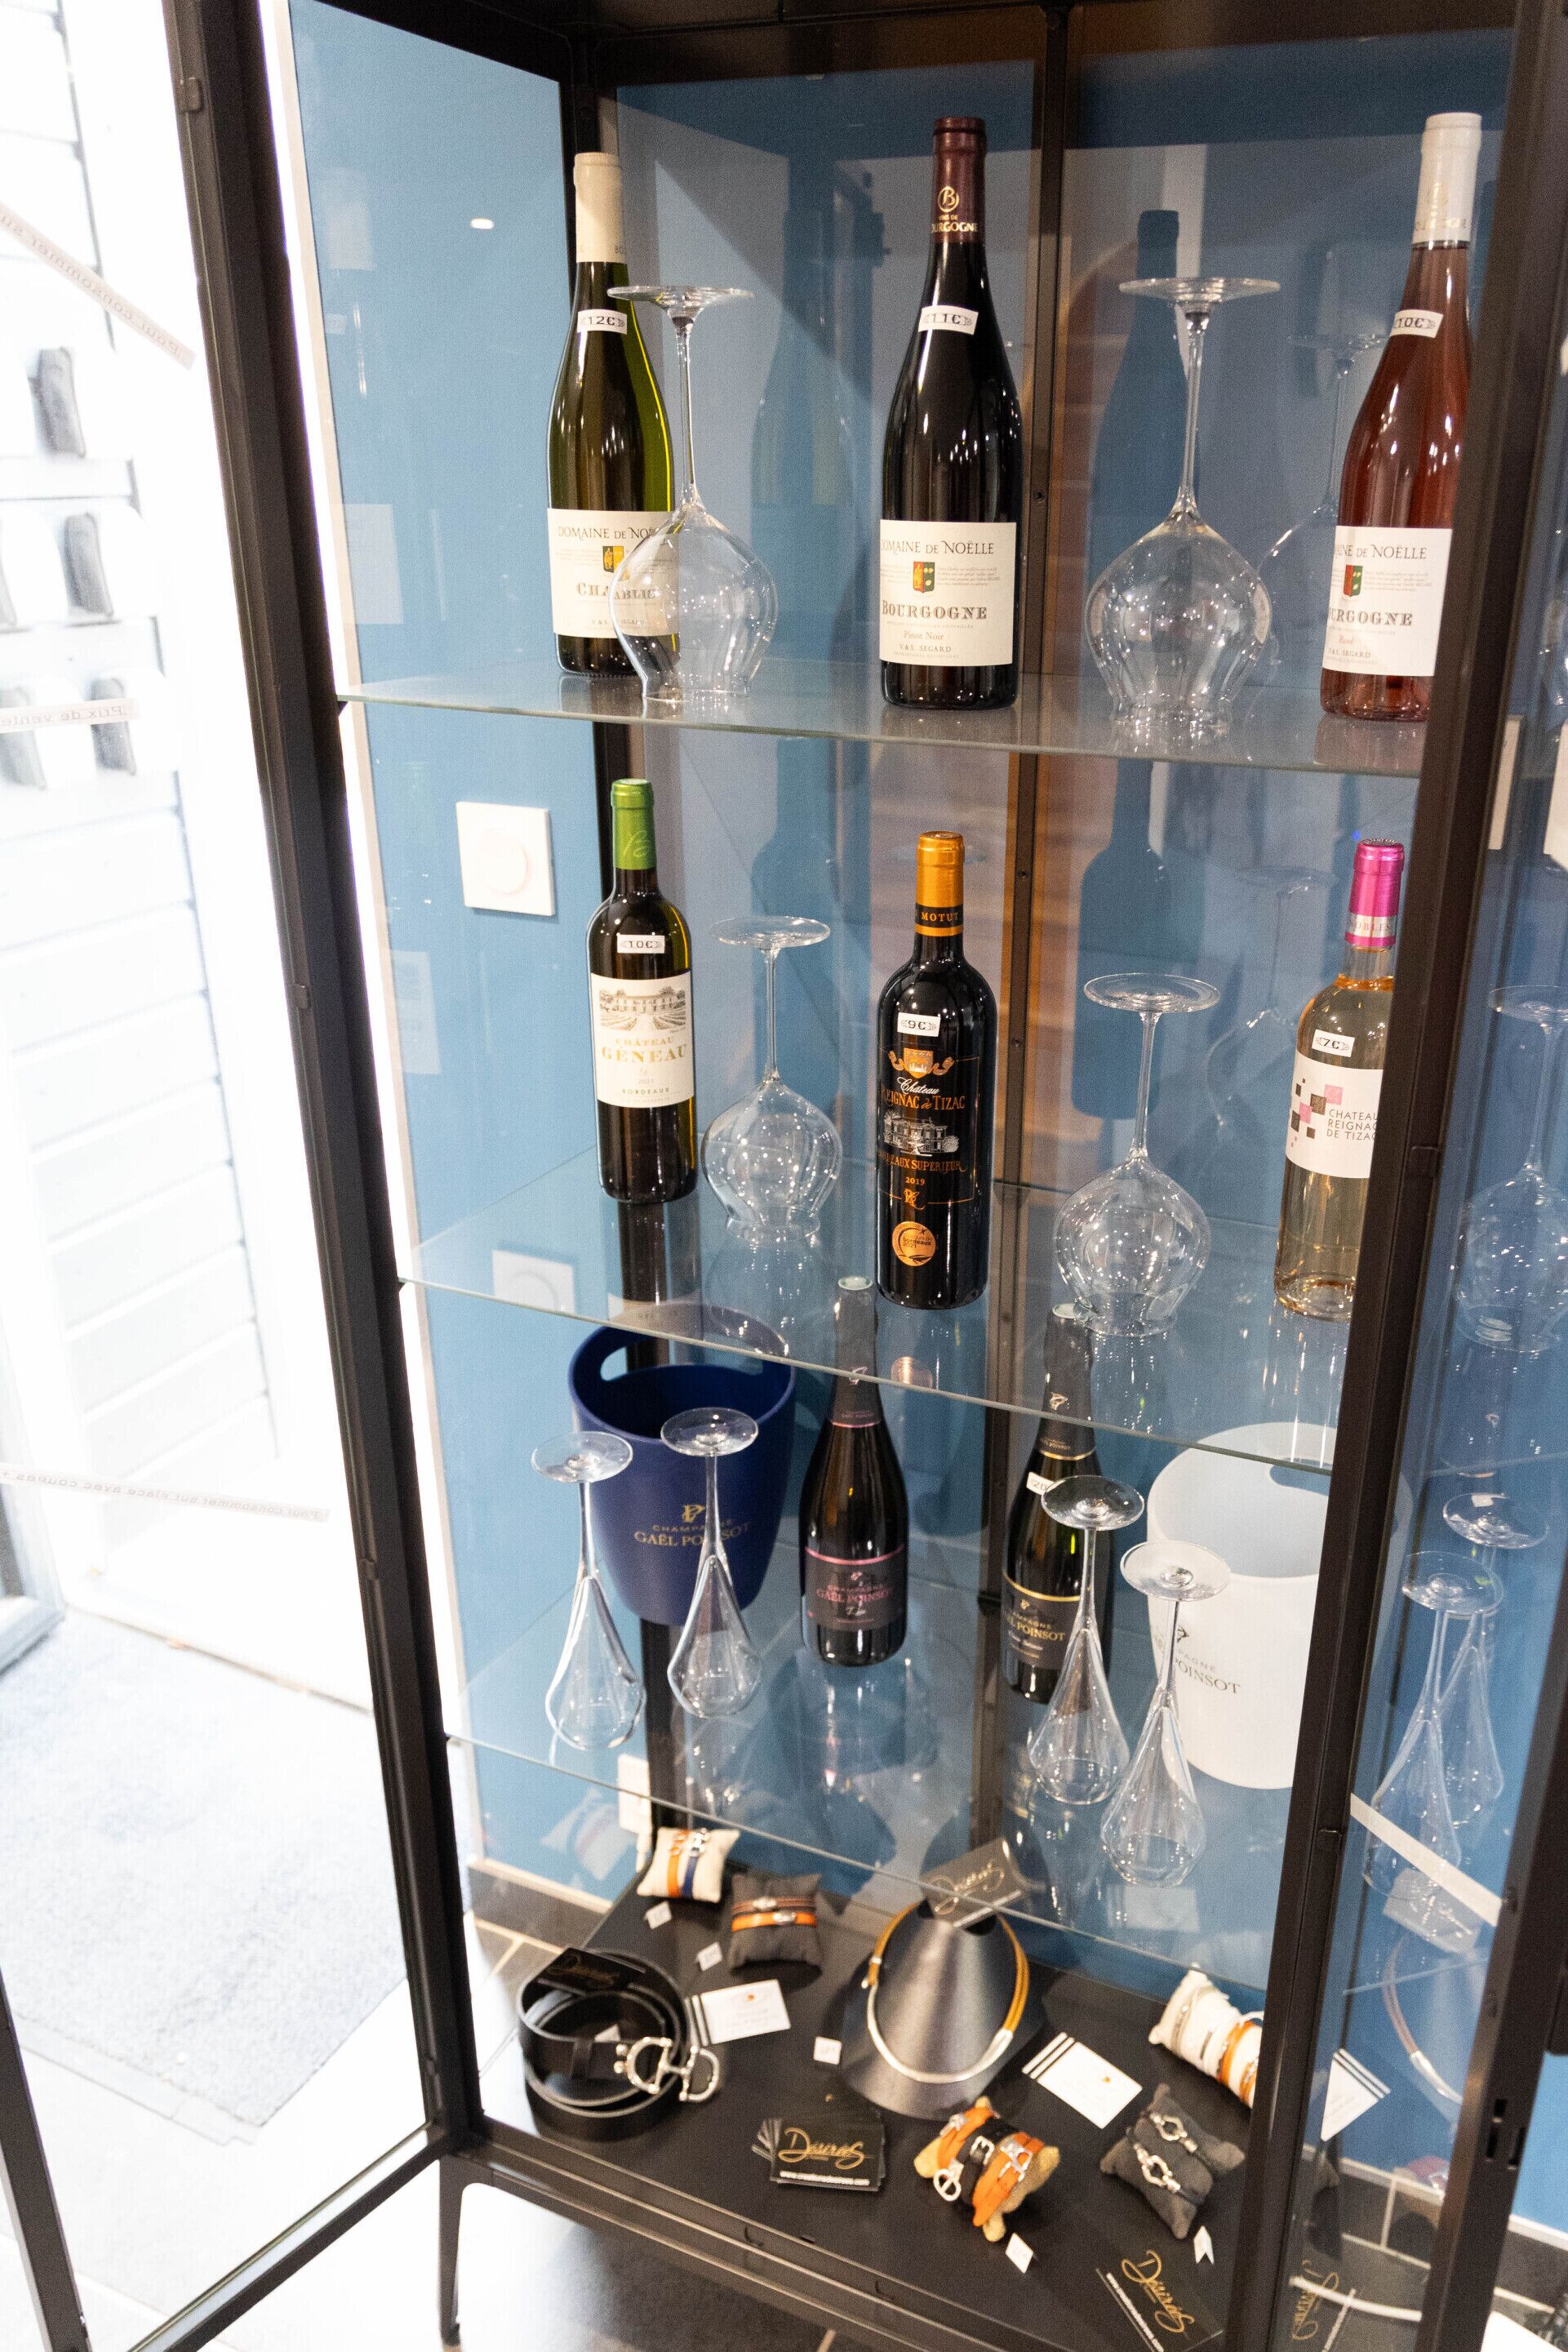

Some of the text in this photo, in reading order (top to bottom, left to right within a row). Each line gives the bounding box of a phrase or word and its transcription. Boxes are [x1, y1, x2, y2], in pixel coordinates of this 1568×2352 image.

[1397, 317, 1424, 328] 10€
[558, 526, 610, 540] DOMAINE
[614, 530, 627, 540] DE
[926, 544, 939, 554] DE
[940, 540, 994, 554] NOËLLE
[1356, 548, 1368, 558] DE
[1371, 544, 1428, 559] NOËLLE
[882, 599, 988, 620] BOURGOGNE
[1328, 607, 1414, 626] OURGOGNE
[904, 630, 944, 641] Pinot Noir
[919, 645, 952, 653] SEGARD
[628, 940, 654, 949] 10€
[908, 1020, 926, 1031] 9€
[1323, 1038, 1339, 1050] 7€
[622, 1087, 670, 1095] BORDEAUX
[933, 1095, 966, 1110] TIZAC
[1326, 1129, 1339, 1139] DE
[904, 1176, 926, 1185] 2019
[633, 1522, 752, 1547] GAËL POSOT
[1015, 1621, 1066, 1642] POINSOT
[1175, 1658, 1241, 1694] OINSOT
